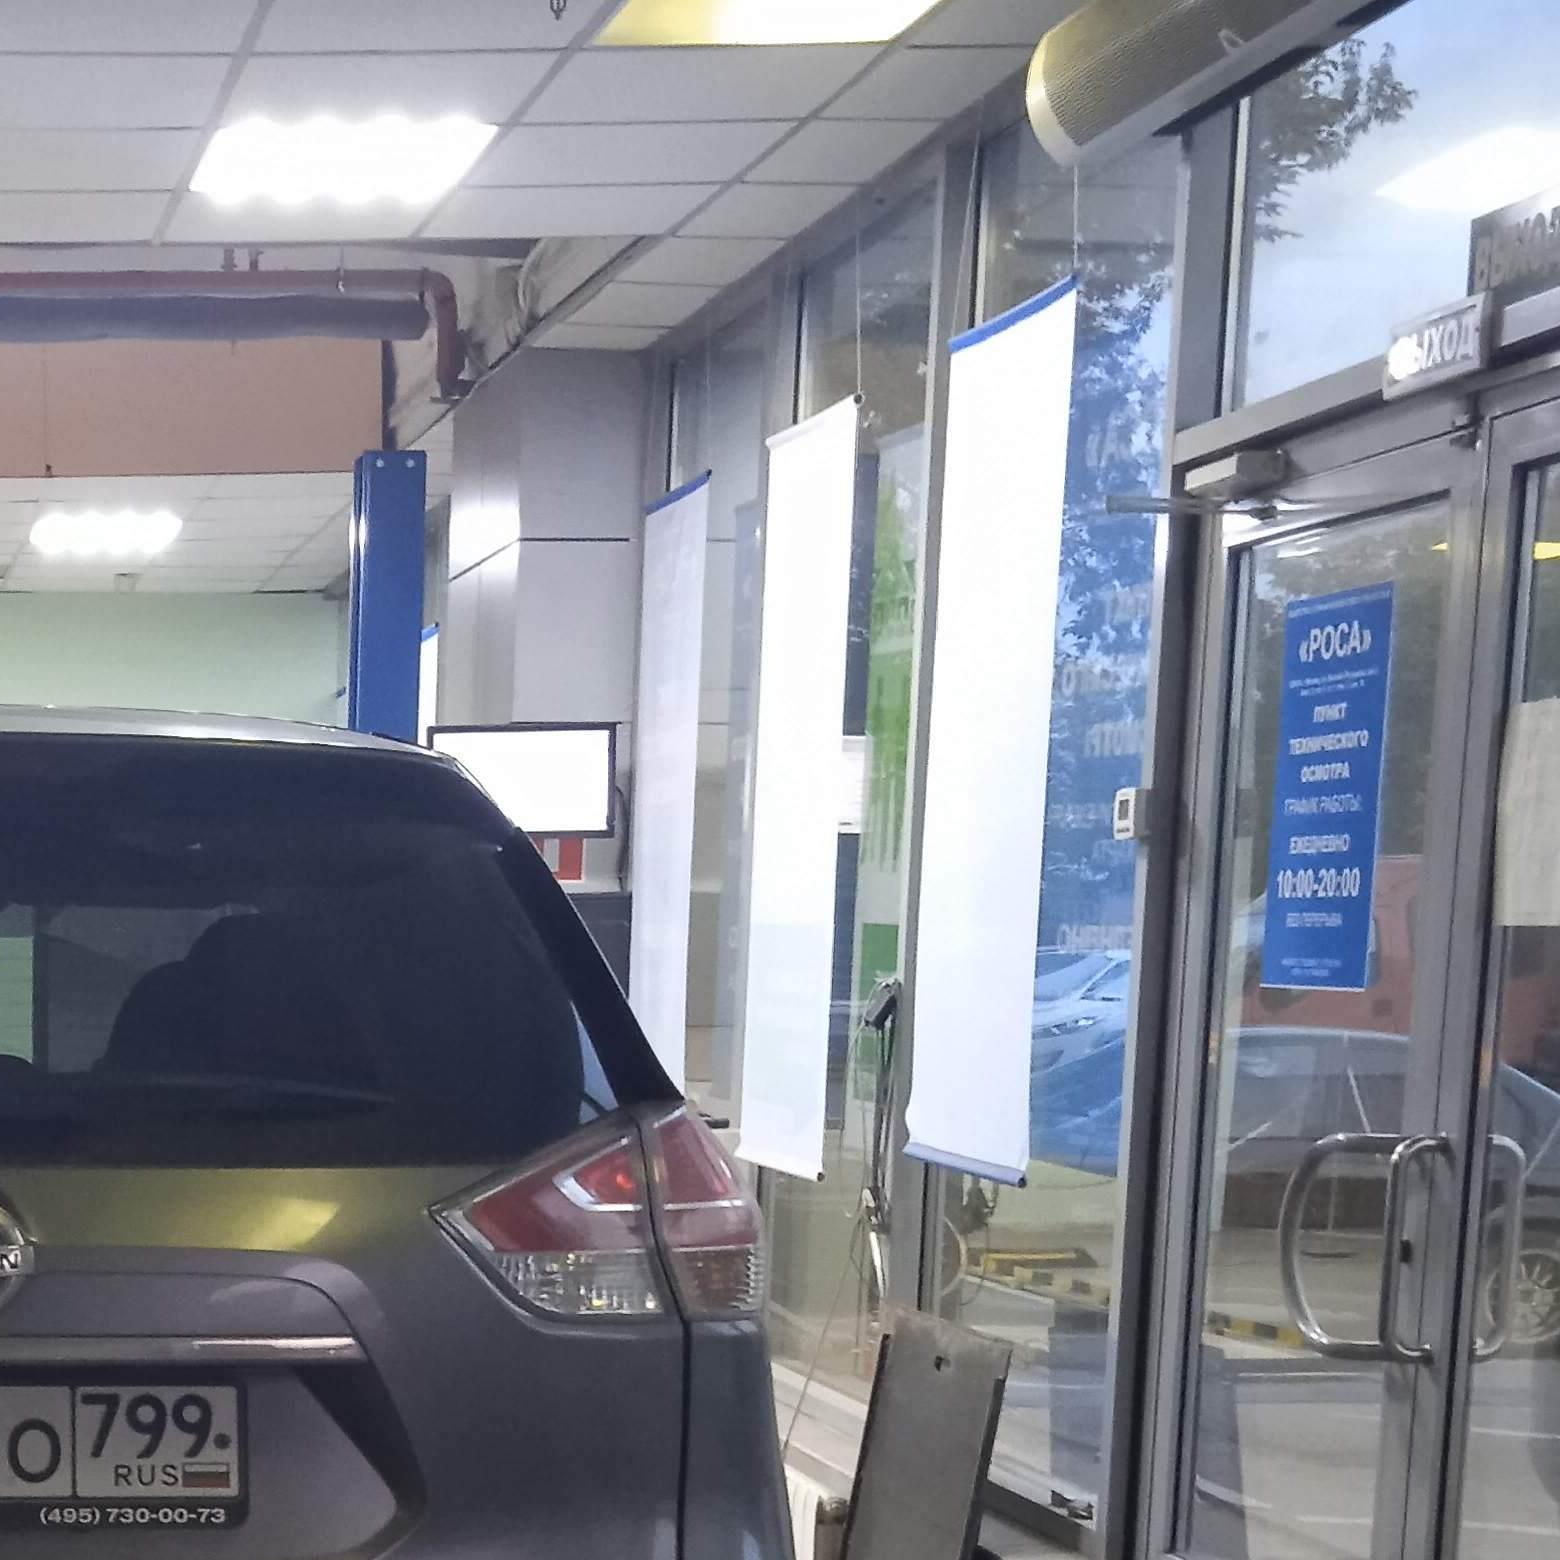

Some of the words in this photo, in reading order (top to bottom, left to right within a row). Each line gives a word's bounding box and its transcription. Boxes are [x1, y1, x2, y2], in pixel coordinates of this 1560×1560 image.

[1389, 318, 1480, 381] ЫХОД
[1299, 620, 1372, 662] «РОСА»
[1277, 867, 1361, 898] 10:00-20:00
[81, 1393, 212, 1459] 799
[114, 1465, 179, 1487] RUS
[40, 1507, 100, 1526] (495)
[106, 1507, 226, 1524] 730-00-73
